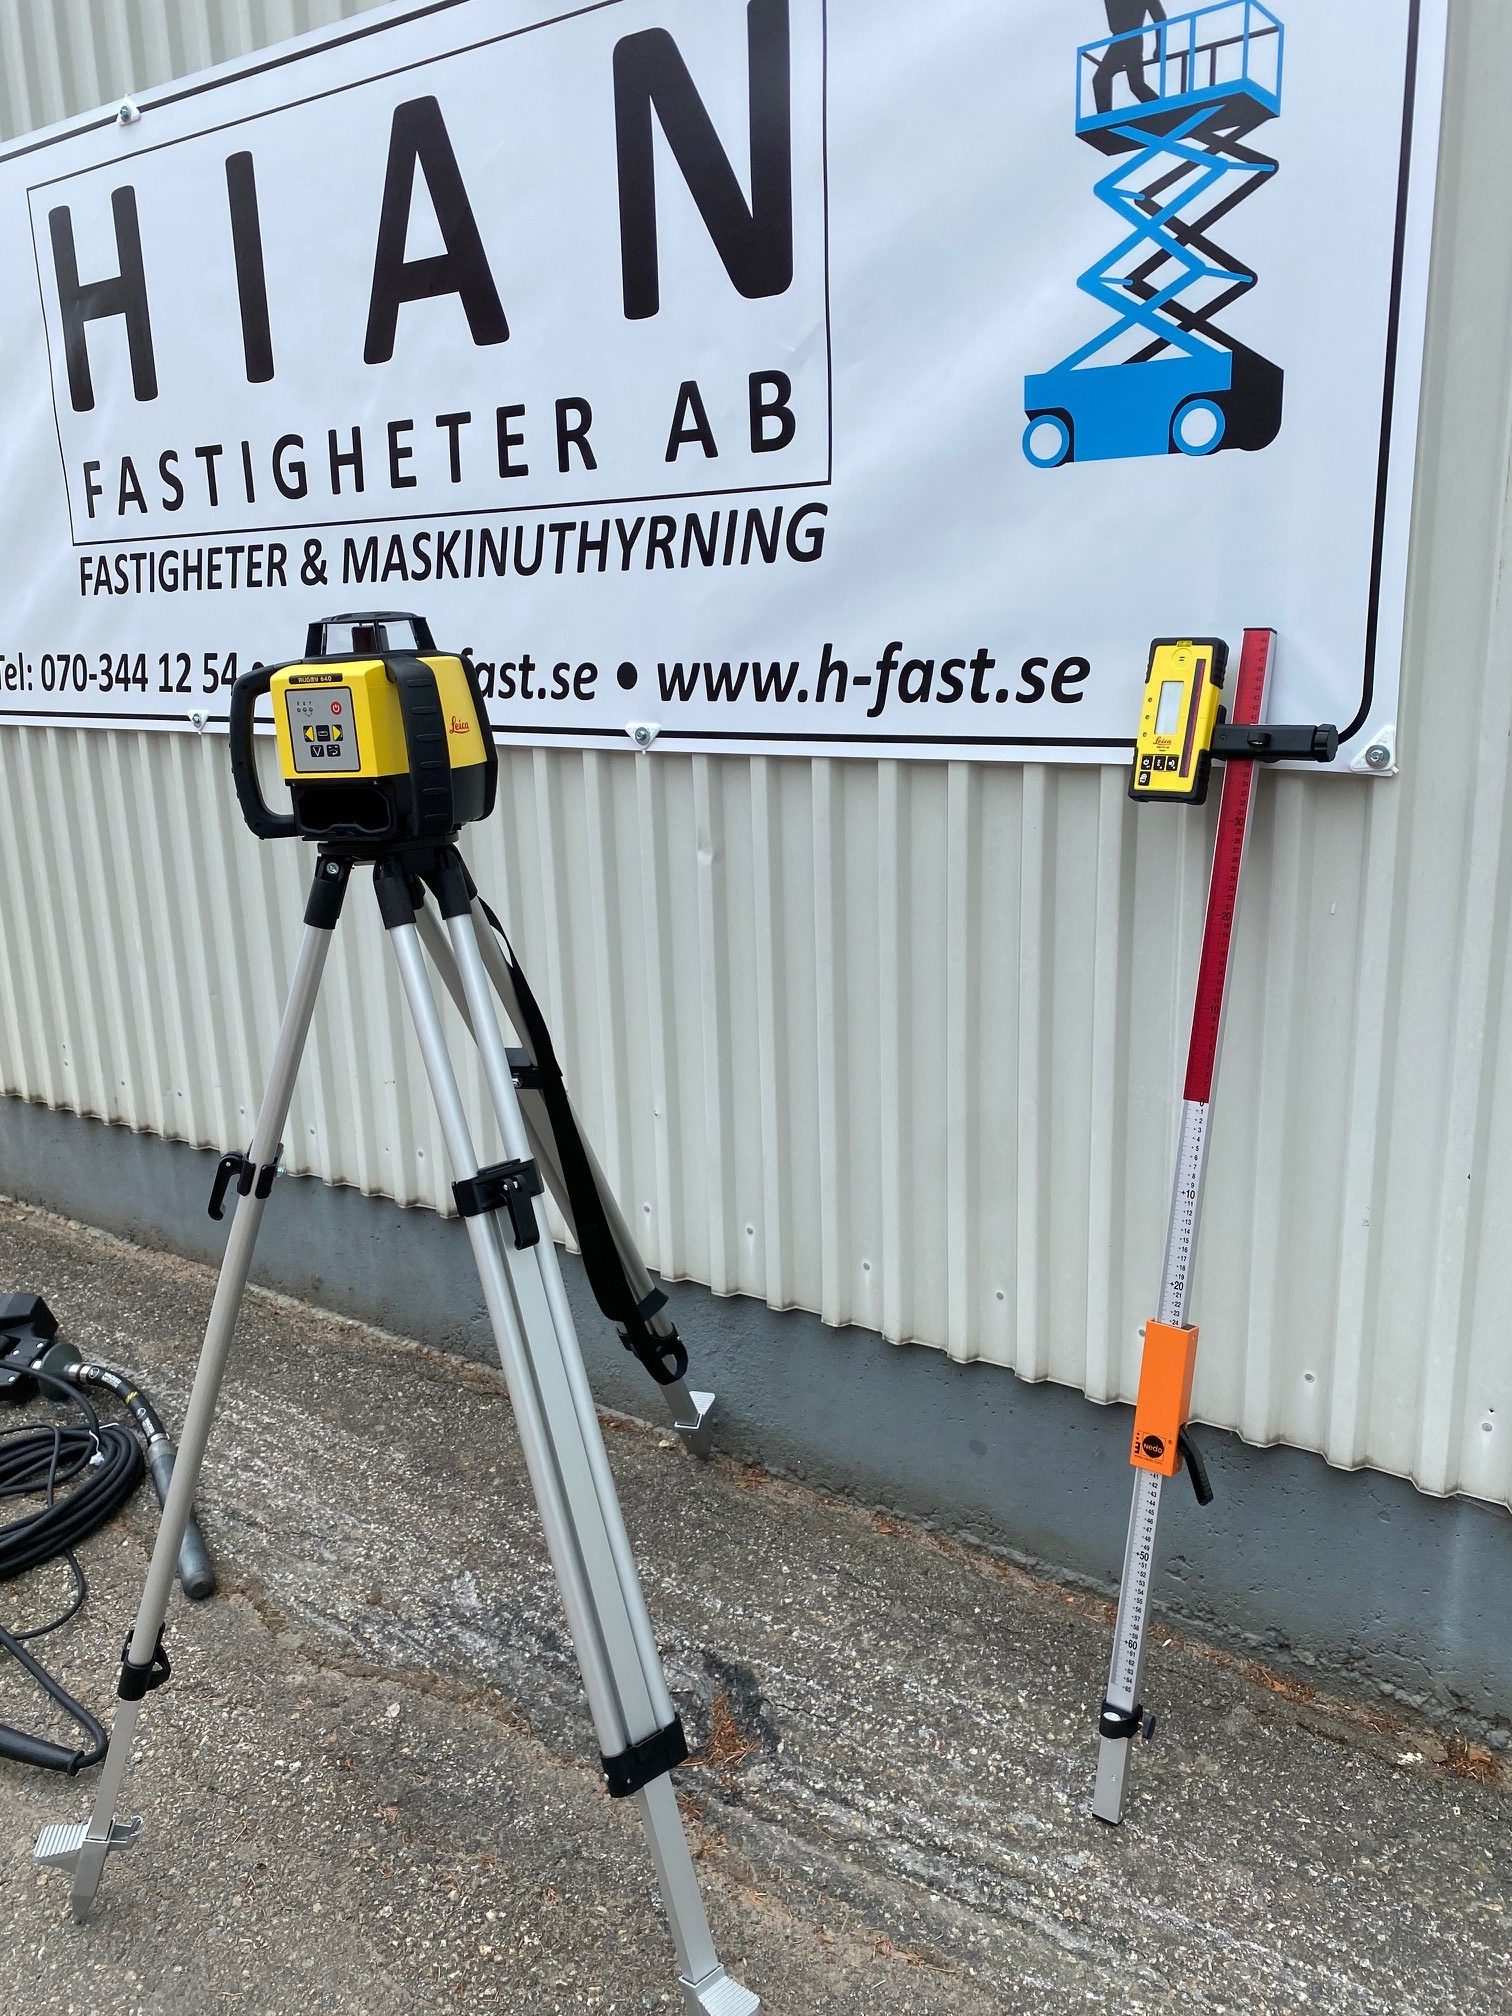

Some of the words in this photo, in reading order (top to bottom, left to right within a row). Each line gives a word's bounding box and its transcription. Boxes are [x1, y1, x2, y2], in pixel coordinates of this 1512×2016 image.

[49, 0, 793, 412] HIAN
[83, 397, 598, 519] FASTIGHETER
[665, 370, 796, 463] AB
[80, 542, 287, 597] FASTIGHETER
[300, 538, 328, 586] &
[342, 502, 829, 584] MASKINUTHYRNING
[41, 653, 149, 693] 070-344
[158, 652, 192, 693] 12
[202, 652, 239, 697] 54
[461, 646, 598, 701] ast.se
[657, 641, 1091, 718] www.h-fast.se
[449, 715, 471, 734] Leica
[1233, 817, 1244, 827] 30
[1222, 912, 1231, 920] 20
[1186, 1190, 1195, 1199] 10
[1174, 1281, 1183, 1290] 20
[1140, 1551, 1149, 1561] 50
[1129, 1640, 1137, 1650] 60
